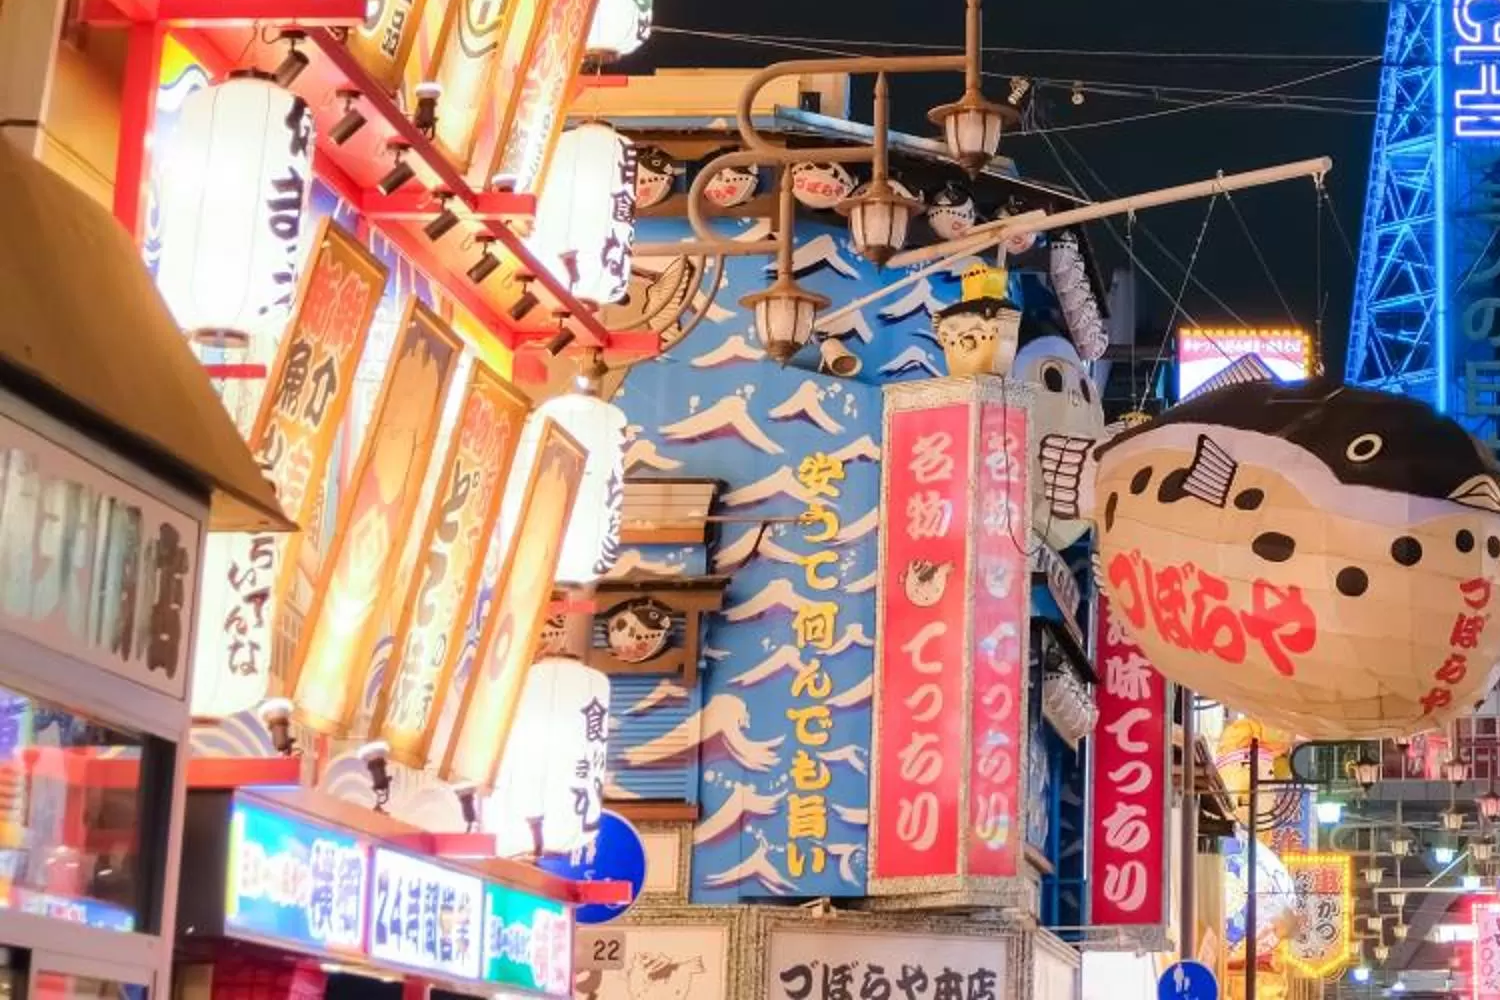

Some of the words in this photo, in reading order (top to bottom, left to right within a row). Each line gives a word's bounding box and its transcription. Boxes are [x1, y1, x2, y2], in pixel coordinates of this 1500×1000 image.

[906, 432, 954, 541] 名物
[983, 434, 1021, 540] 名物
[786, 450, 846, 878] 安うて何んでも旨い
[593, 939, 620, 961] 22
